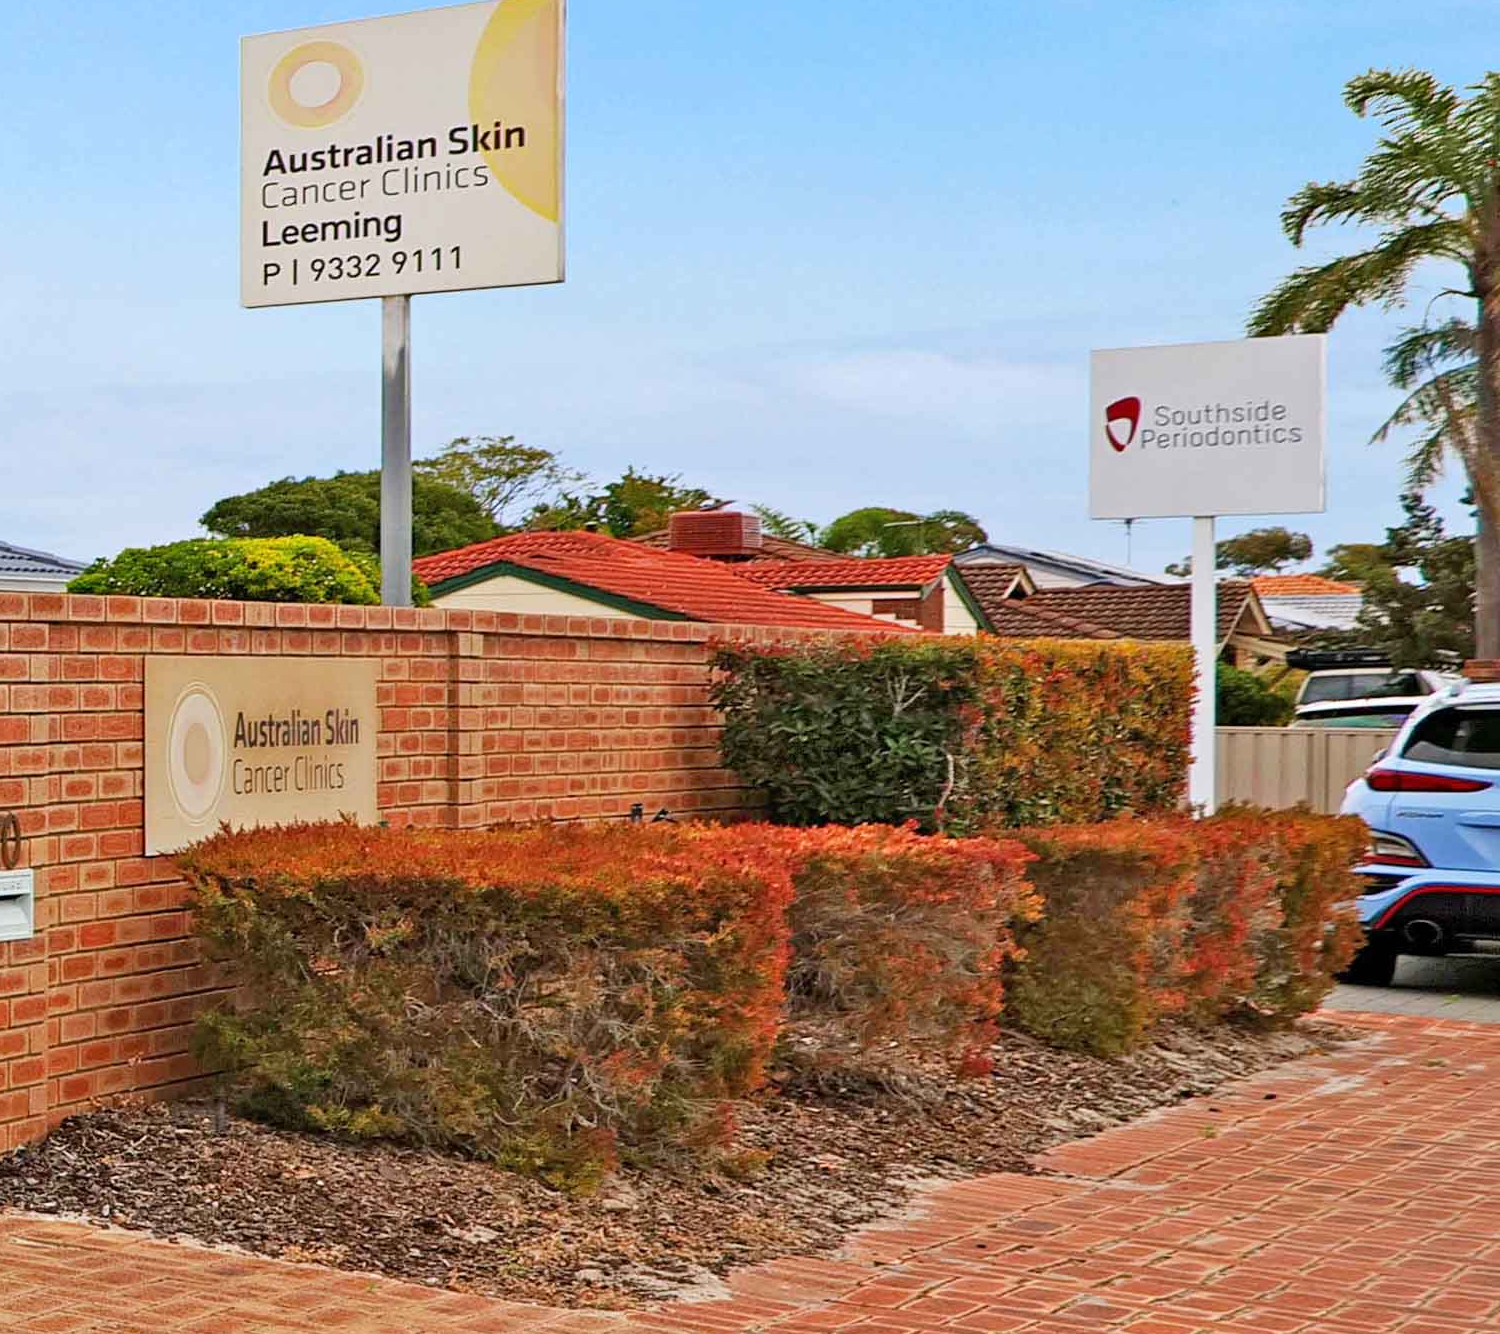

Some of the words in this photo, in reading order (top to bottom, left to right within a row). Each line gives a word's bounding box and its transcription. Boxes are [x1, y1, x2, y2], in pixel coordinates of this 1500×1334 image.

[262, 135, 437, 177] Australian
[448, 121, 526, 156] Skin
[261, 176, 371, 210] Cancer
[381, 163, 490, 197] Clinics
[261, 211, 402, 247] Leeming
[263, 262, 281, 286] P
[310, 253, 381, 282] 9332
[391, 245, 462, 275] 9111
[1154, 400, 1287, 427] Southside
[1140, 423, 1303, 450] Periodontics
[233, 709, 321, 748] Australian
[325, 708, 359, 746] Skin
[232, 758, 290, 795] Cancer
[294, 754, 345, 791] Clinics
